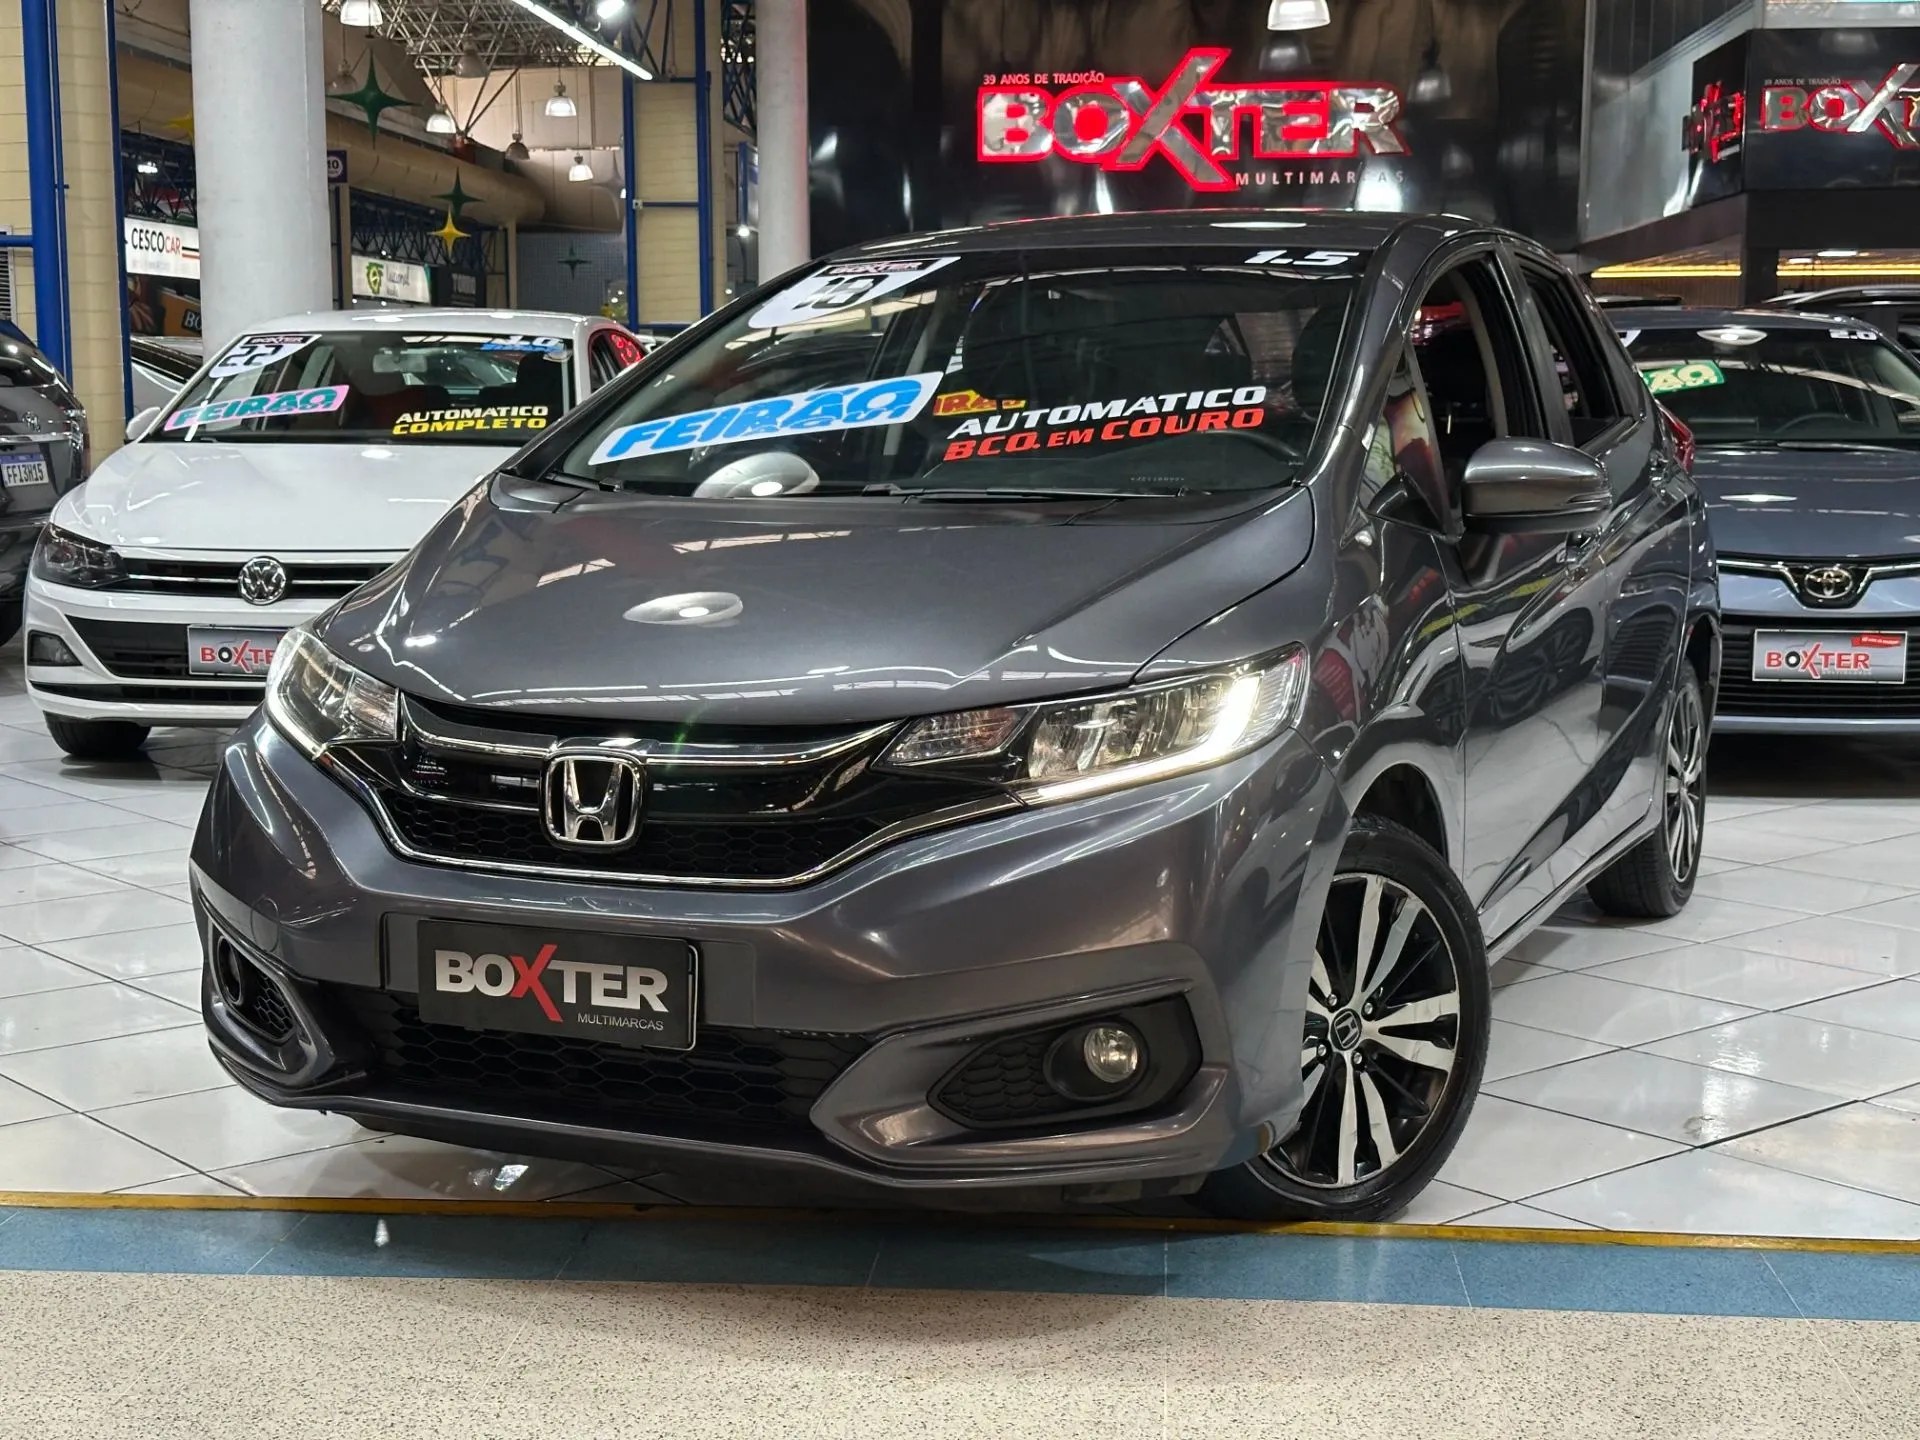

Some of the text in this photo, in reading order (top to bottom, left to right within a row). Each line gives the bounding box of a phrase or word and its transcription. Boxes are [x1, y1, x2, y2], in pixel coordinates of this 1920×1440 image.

[983, 70, 1105, 86] 39 ANOS DE TRADIÇÃO
[977, 47, 1411, 192] BOXTER
[1235, 170, 1404, 186] MULTIMARAS
[1244, 249, 1360, 266] 1.5
[392, 418, 547, 435] COMPLETO
[1047, 428, 1095, 448] EM
[1100, 408, 1265, 440] COURO
[1765, 642, 1871, 679] BOXTER
[435, 944, 669, 1022] BOXTER
[577, 1012, 664, 1031] MULTIMARCAS
